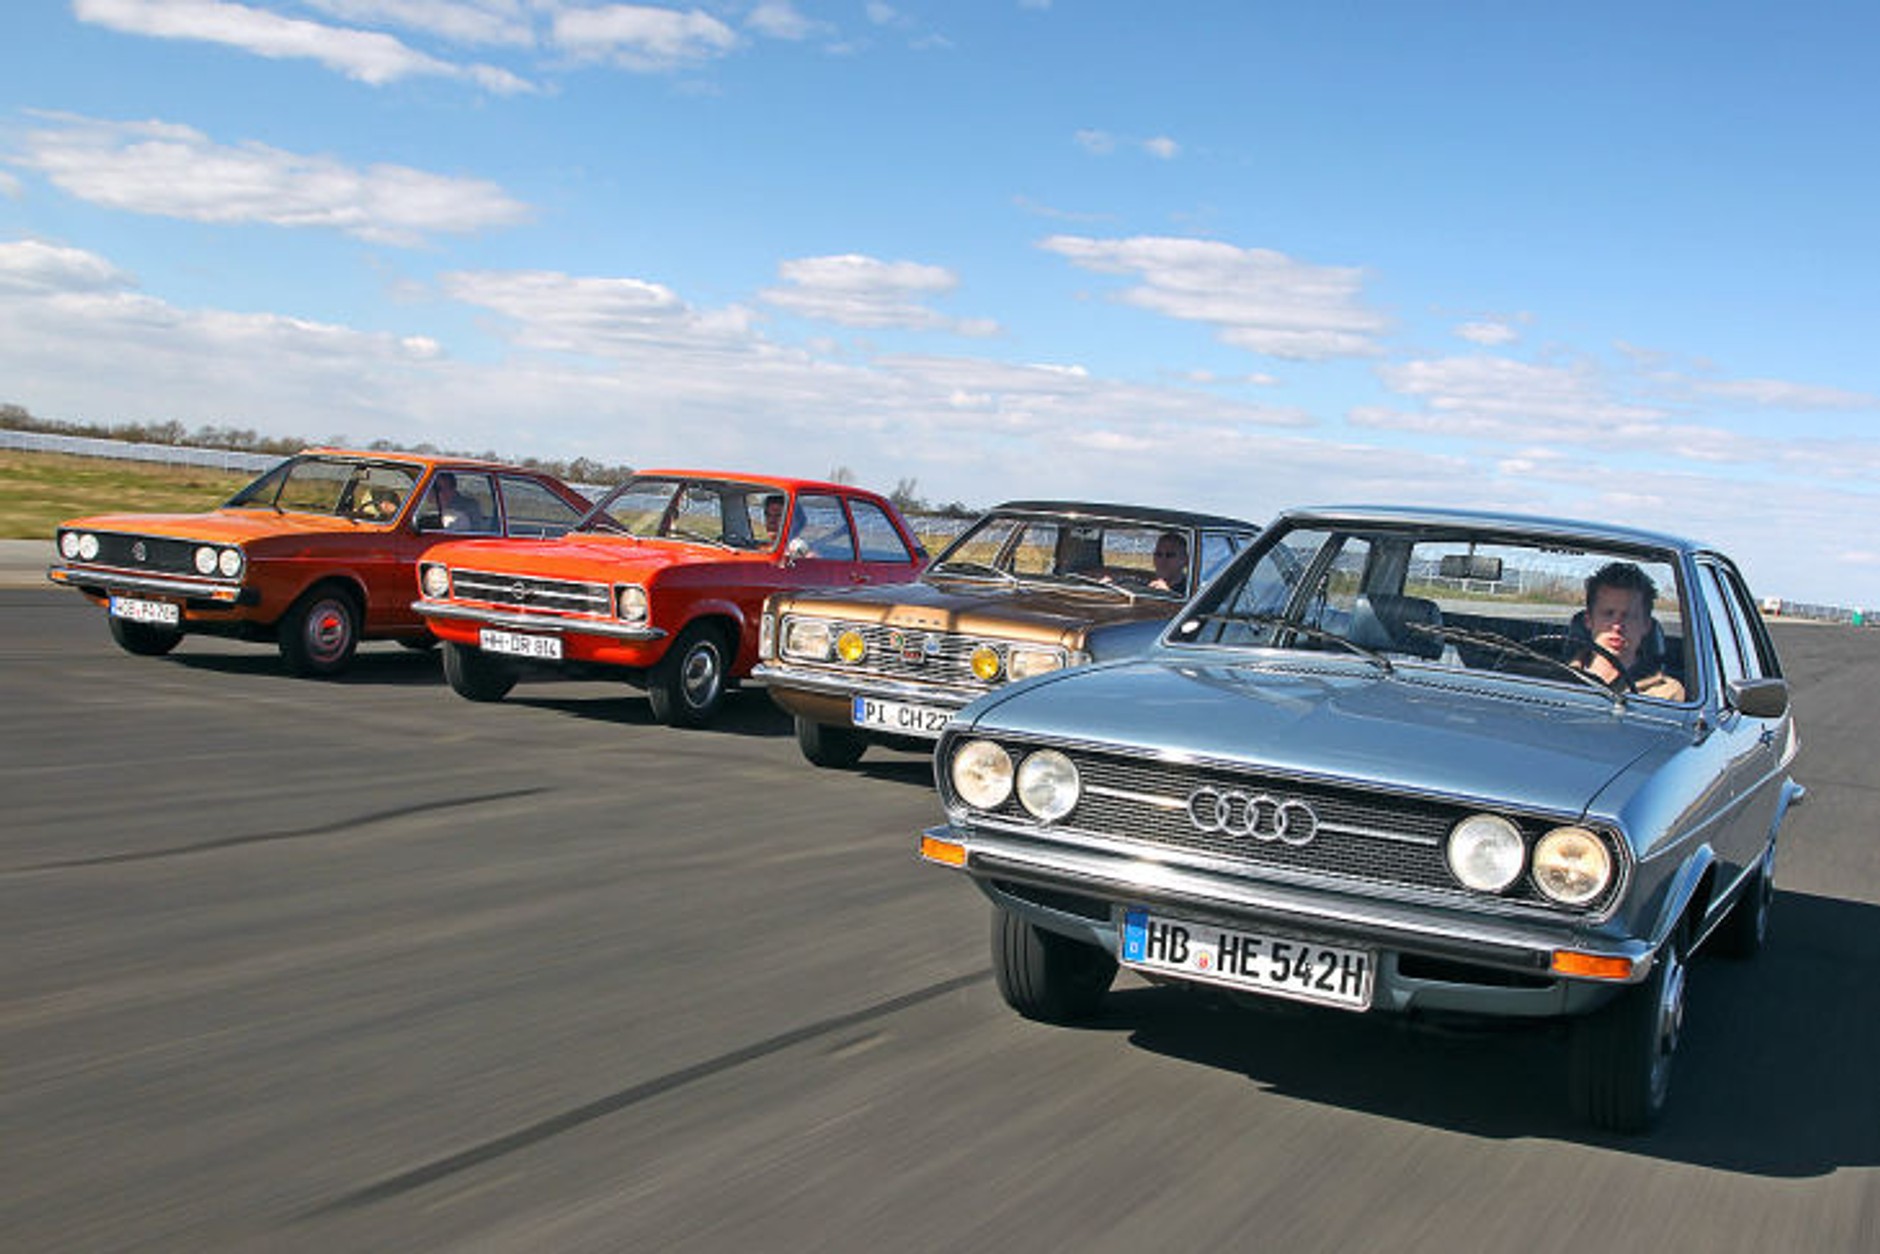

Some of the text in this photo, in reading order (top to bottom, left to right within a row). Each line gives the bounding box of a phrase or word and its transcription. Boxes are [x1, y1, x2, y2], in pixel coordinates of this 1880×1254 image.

[866, 702, 954, 731] PI CH 22
[1147, 921, 1190, 964] HB
[1217, 933, 1262, 979] HE
[1270, 941, 1365, 997] 542H
